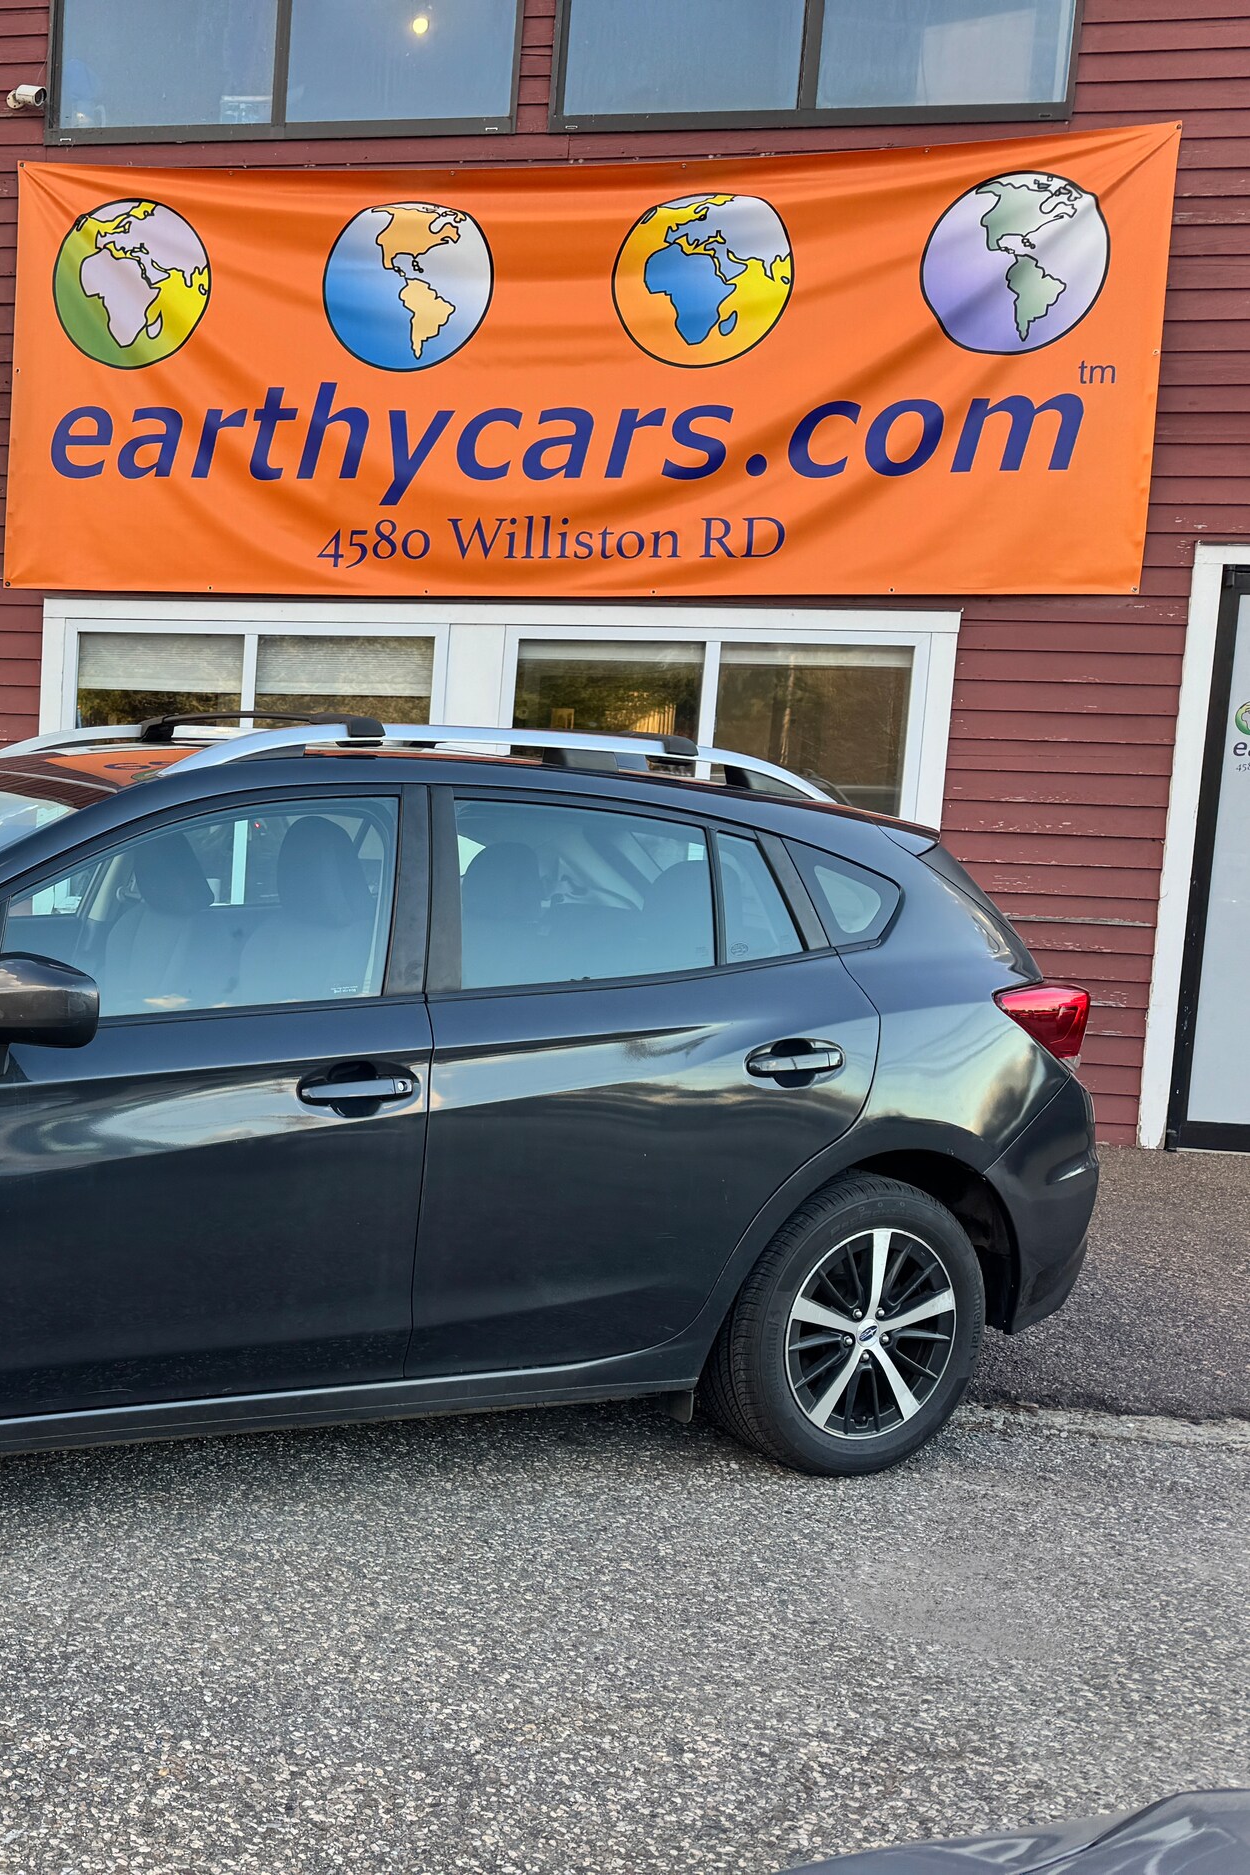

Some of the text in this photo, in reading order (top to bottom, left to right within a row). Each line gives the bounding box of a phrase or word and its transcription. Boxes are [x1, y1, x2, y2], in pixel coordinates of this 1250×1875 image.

[51, 360, 1116, 506] earthycars.com tm
[317, 516, 785, 568] 4580 Williston RD
